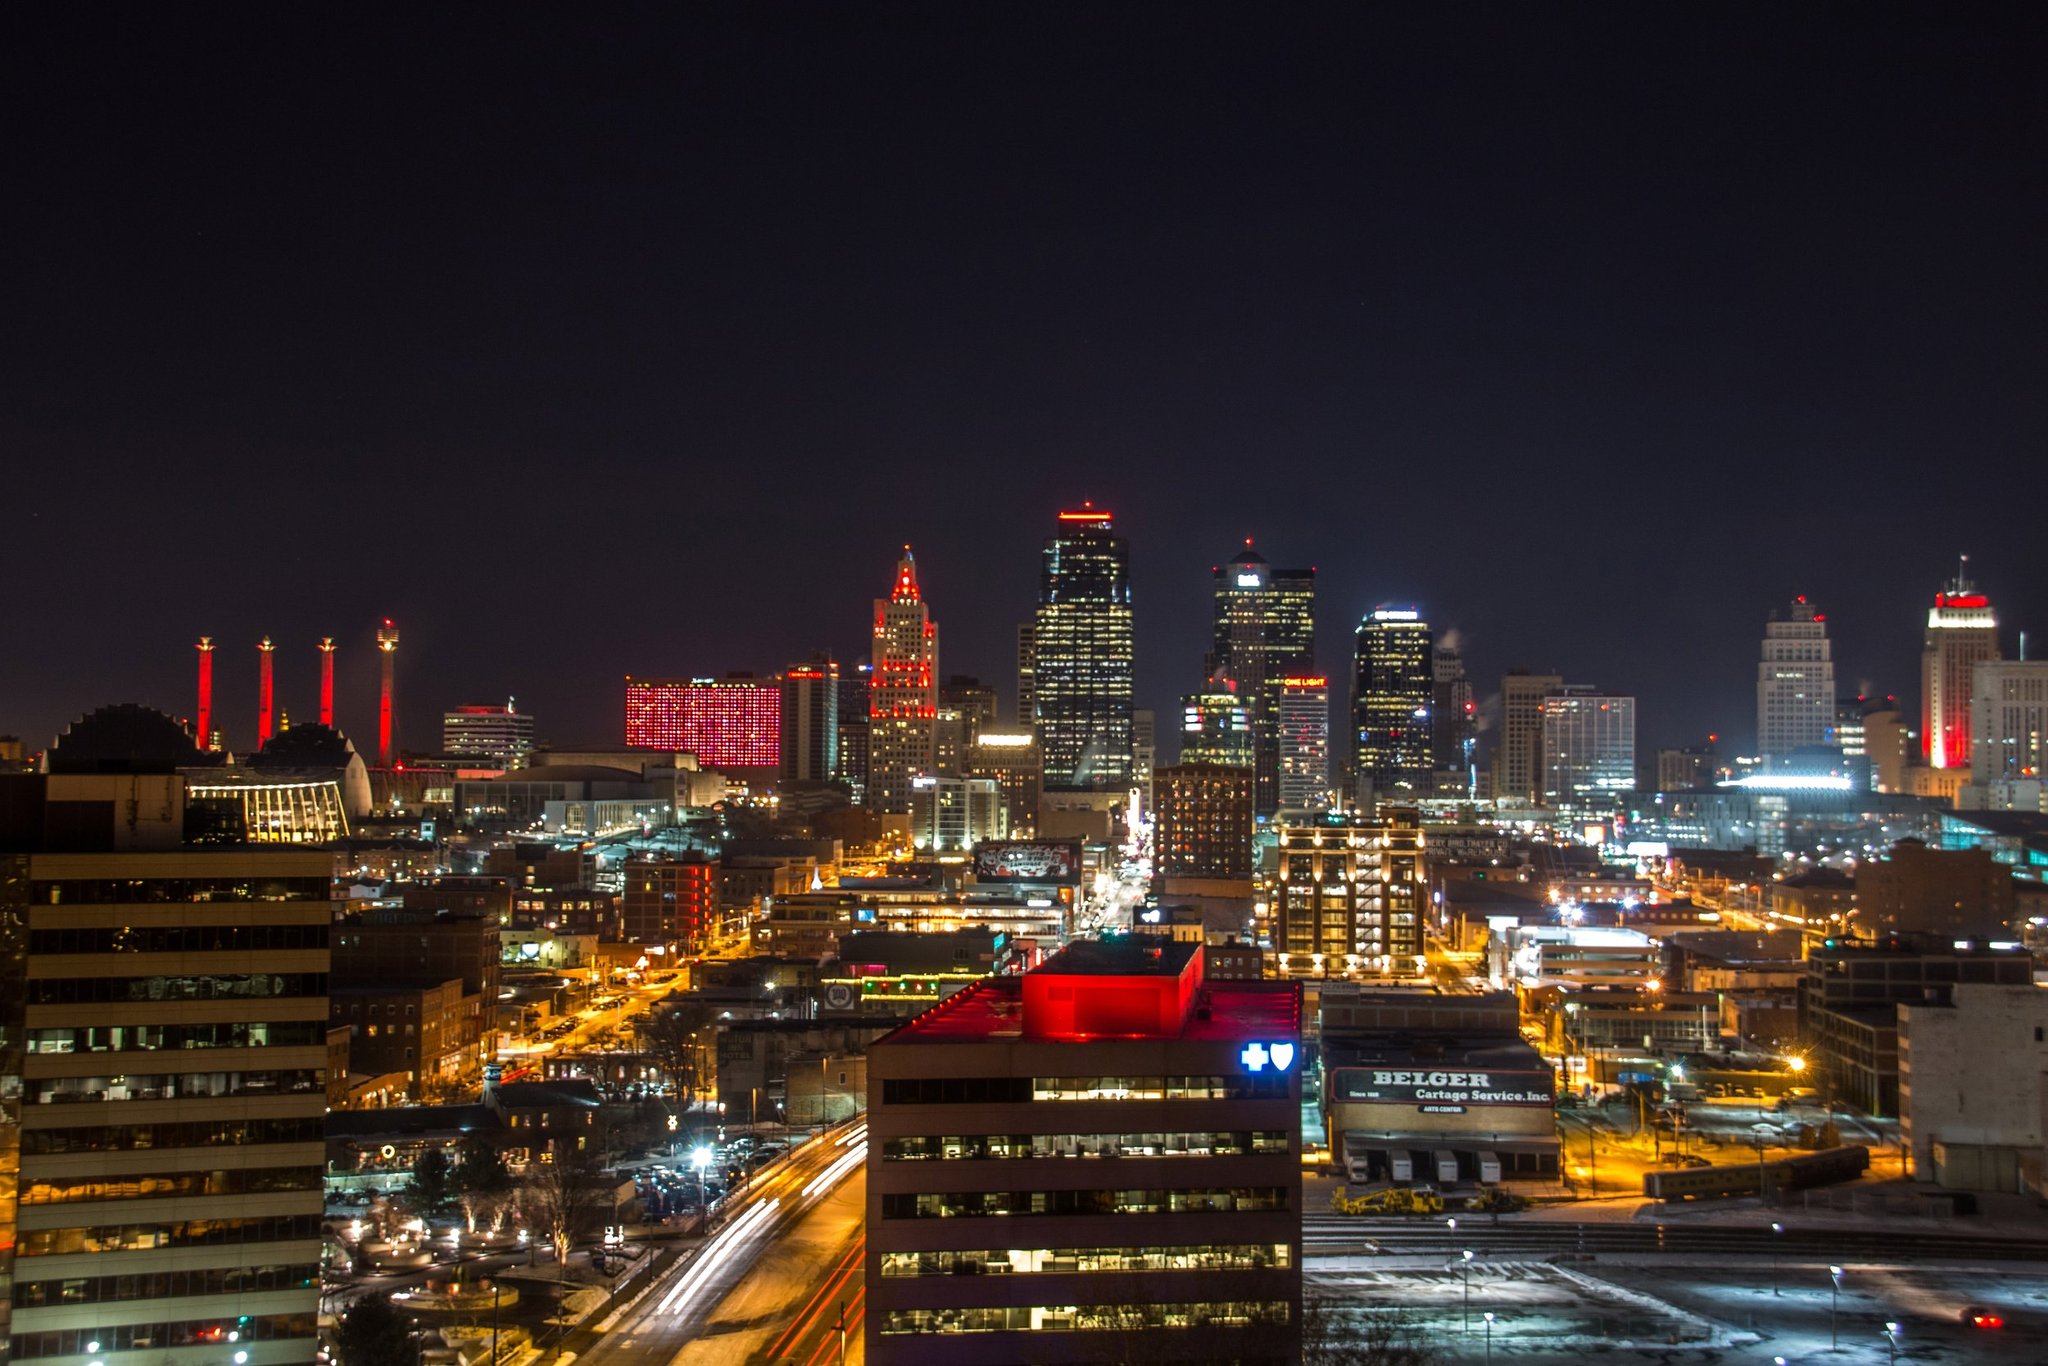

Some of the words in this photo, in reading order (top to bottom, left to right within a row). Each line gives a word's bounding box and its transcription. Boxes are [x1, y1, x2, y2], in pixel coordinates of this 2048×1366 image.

[1284, 678, 1301, 686] ONE
[1302, 678, 1325, 686] LIGHT
[1373, 1071, 1490, 1087] BELGER
[1416, 1088, 1467, 1103] Cartage
